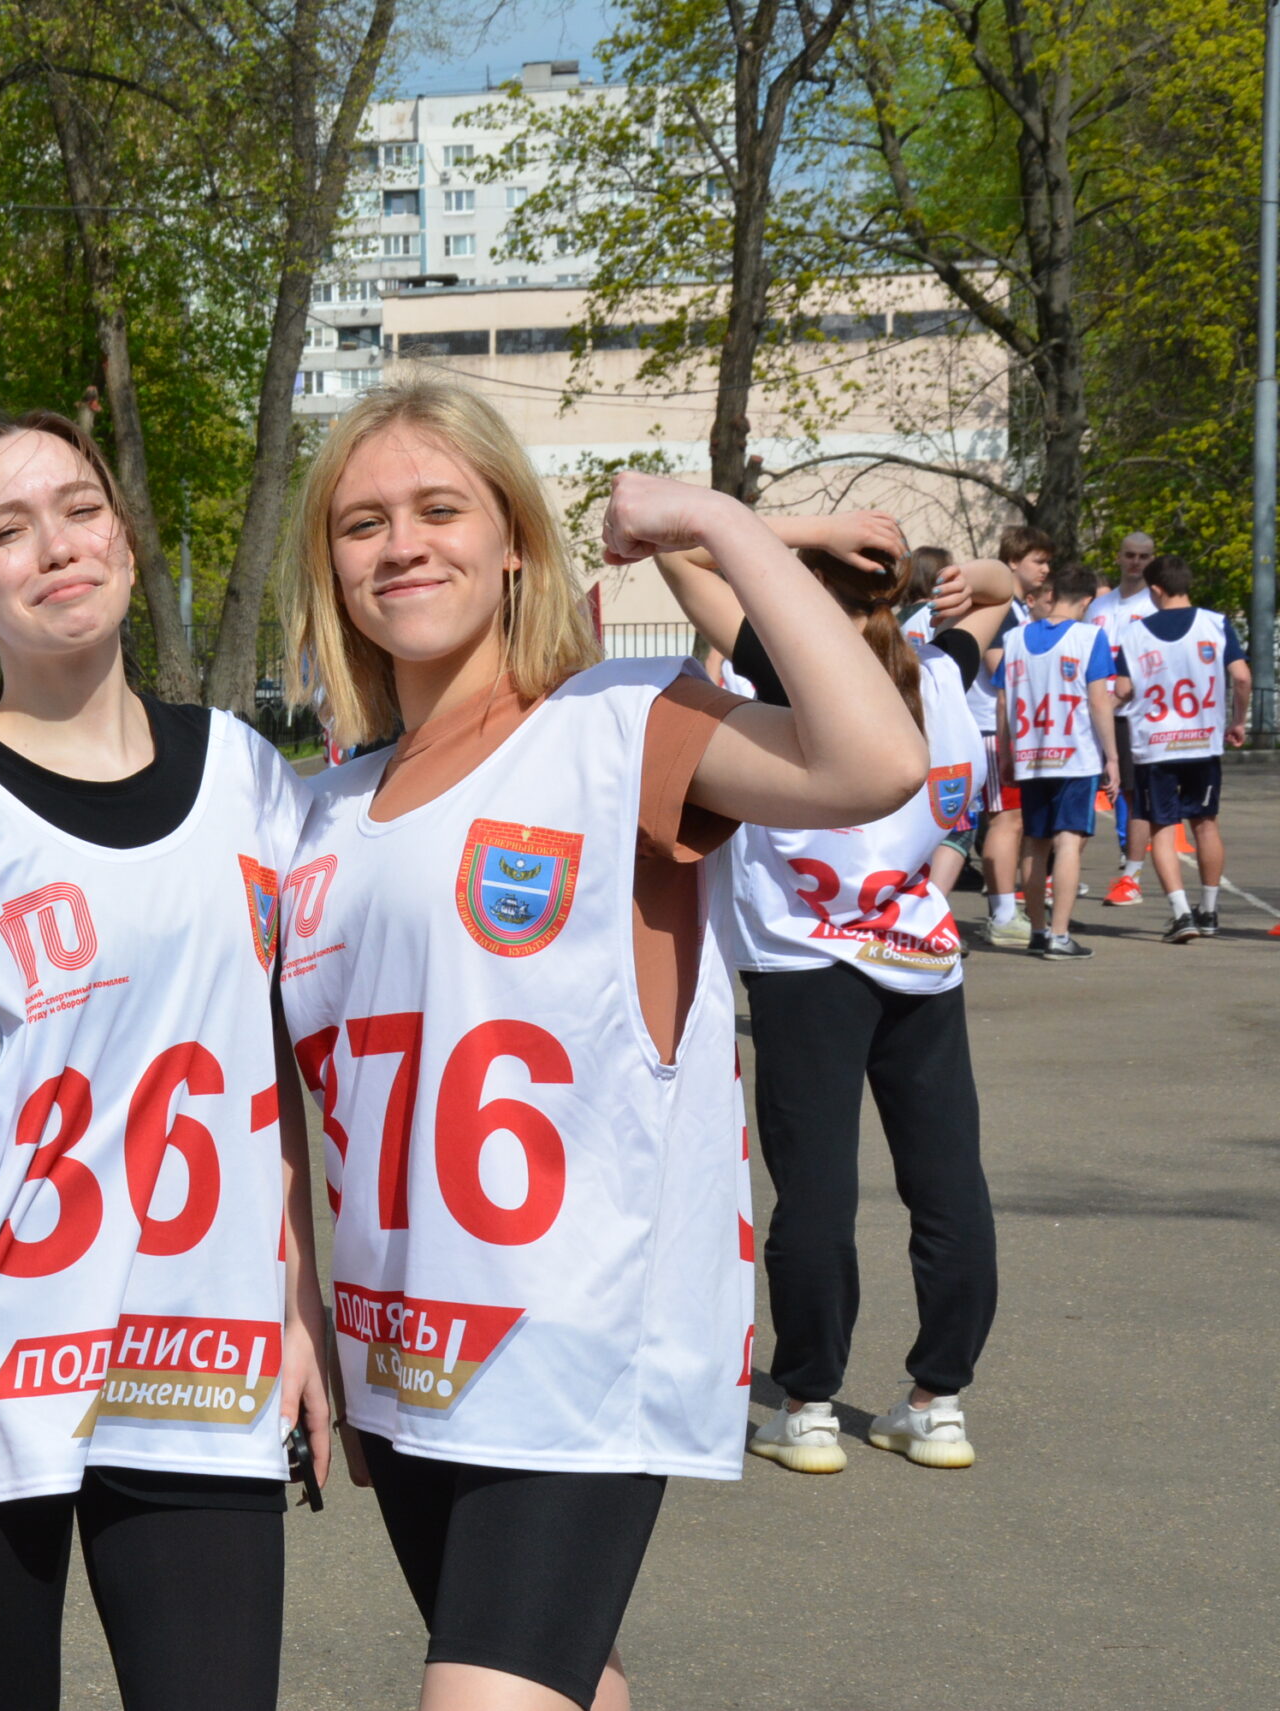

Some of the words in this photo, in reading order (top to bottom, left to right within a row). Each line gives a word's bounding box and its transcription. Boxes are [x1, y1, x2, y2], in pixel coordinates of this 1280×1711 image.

[483, 835, 535, 854] СЕВЕРНЫЙ
[536, 846, 566, 856] ОКРУГ
[93, 976, 130, 989] комплекс
[375, 1353, 388, 1375] к
